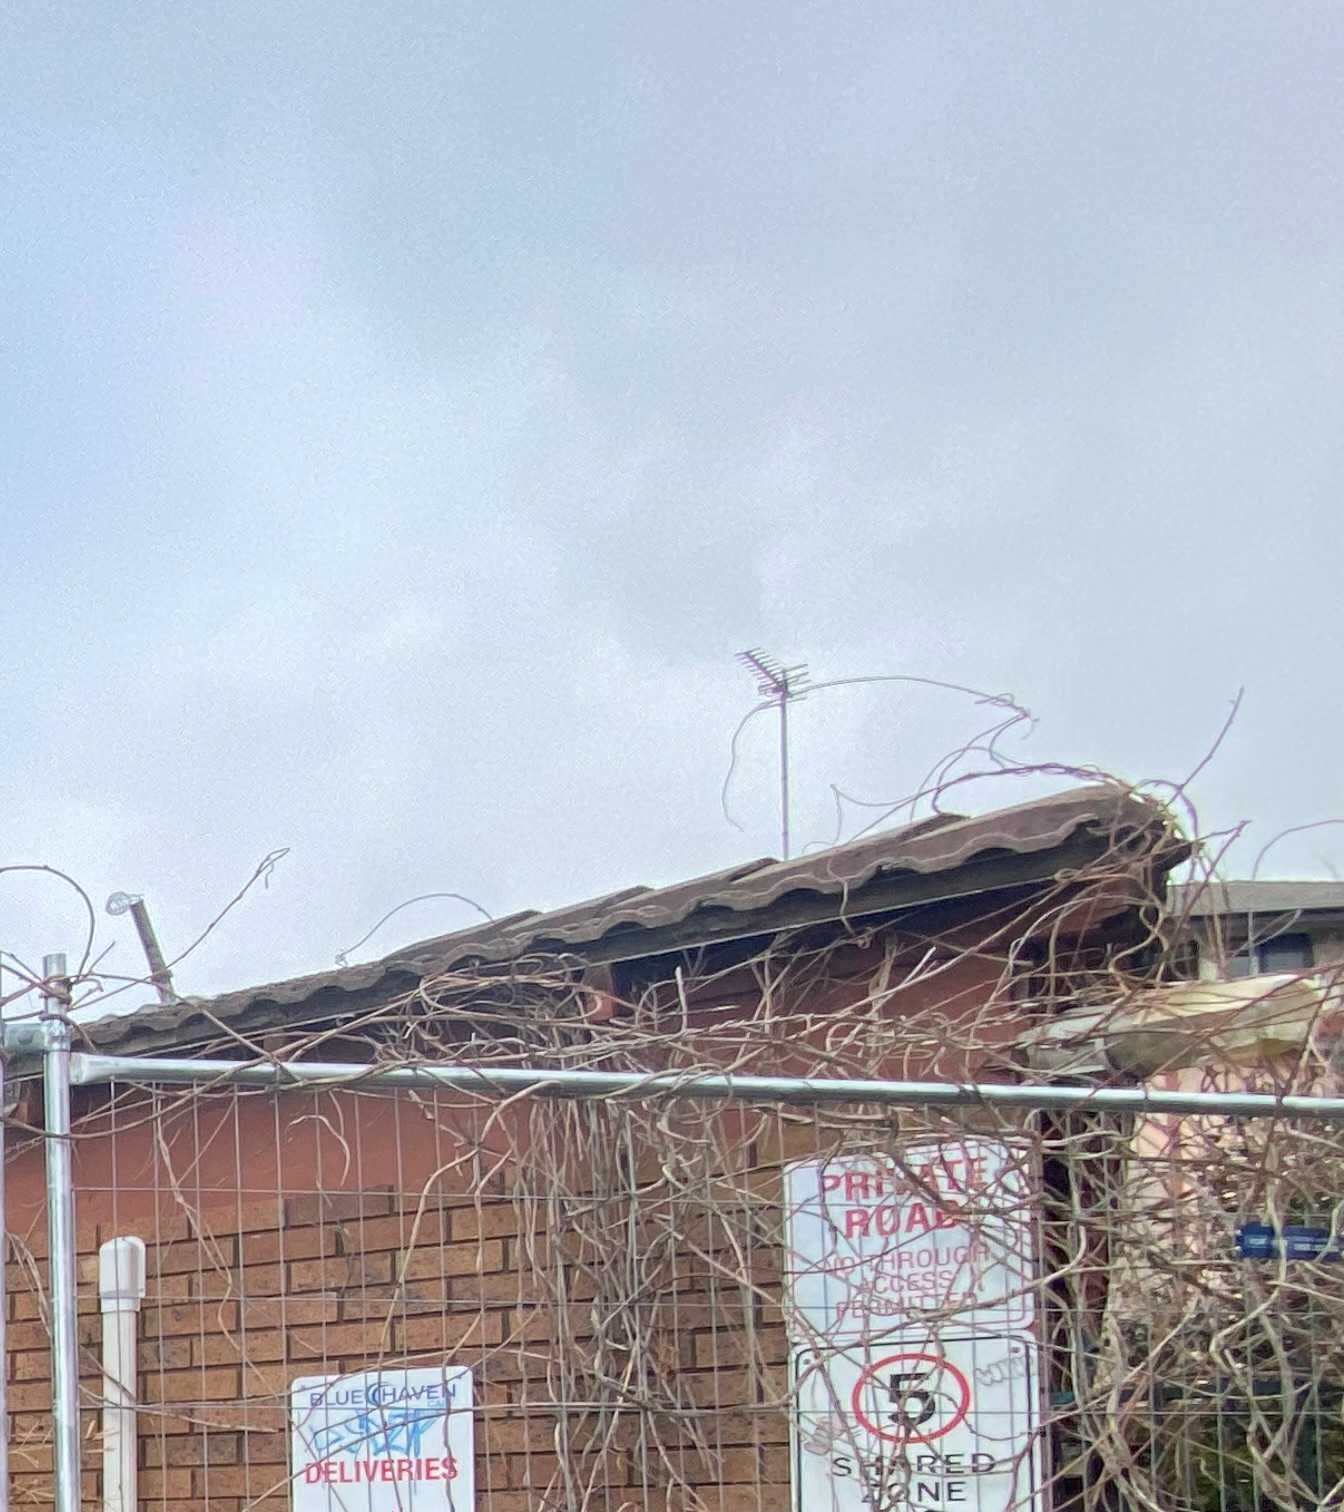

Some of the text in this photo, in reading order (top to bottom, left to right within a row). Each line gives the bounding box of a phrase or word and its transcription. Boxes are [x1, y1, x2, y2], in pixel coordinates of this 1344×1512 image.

[821, 1156, 988, 1202] PRIATE
[845, 1200, 960, 1239] ROAD
[310, 1383, 457, 1407] BLUE HAVEN
[888, 1373, 936, 1426] 5
[304, 1457, 458, 1484] DELIVERIES
[832, 1453, 996, 1477] SHRED
